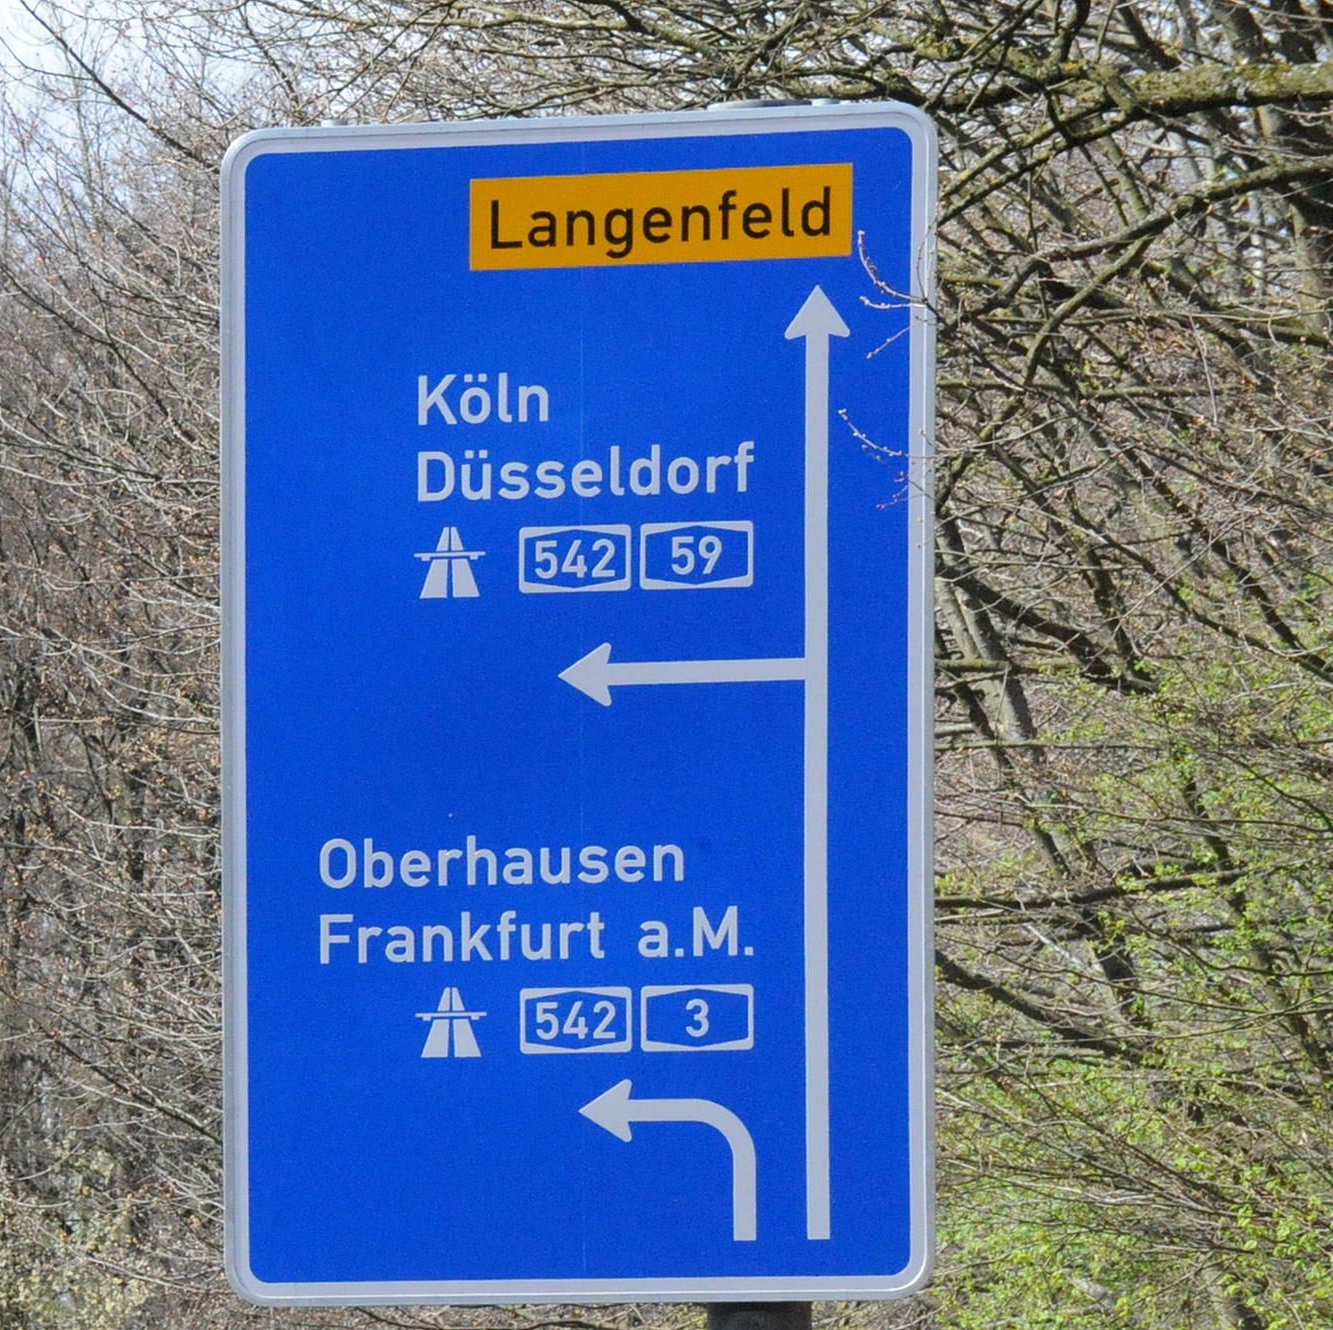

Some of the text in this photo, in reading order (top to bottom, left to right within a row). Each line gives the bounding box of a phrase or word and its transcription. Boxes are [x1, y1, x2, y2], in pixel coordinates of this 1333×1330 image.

[489, 185, 832, 259] Langenfeld
[418, 372, 549, 426] Köln
[417, 441, 755, 502] Düsseldorf
[535, 535, 722, 579] 542 59
[319, 835, 684, 889] Oberhausen
[320, 905, 754, 964] Frankfurt a.M.
[536, 998, 710, 1040] 542 3
